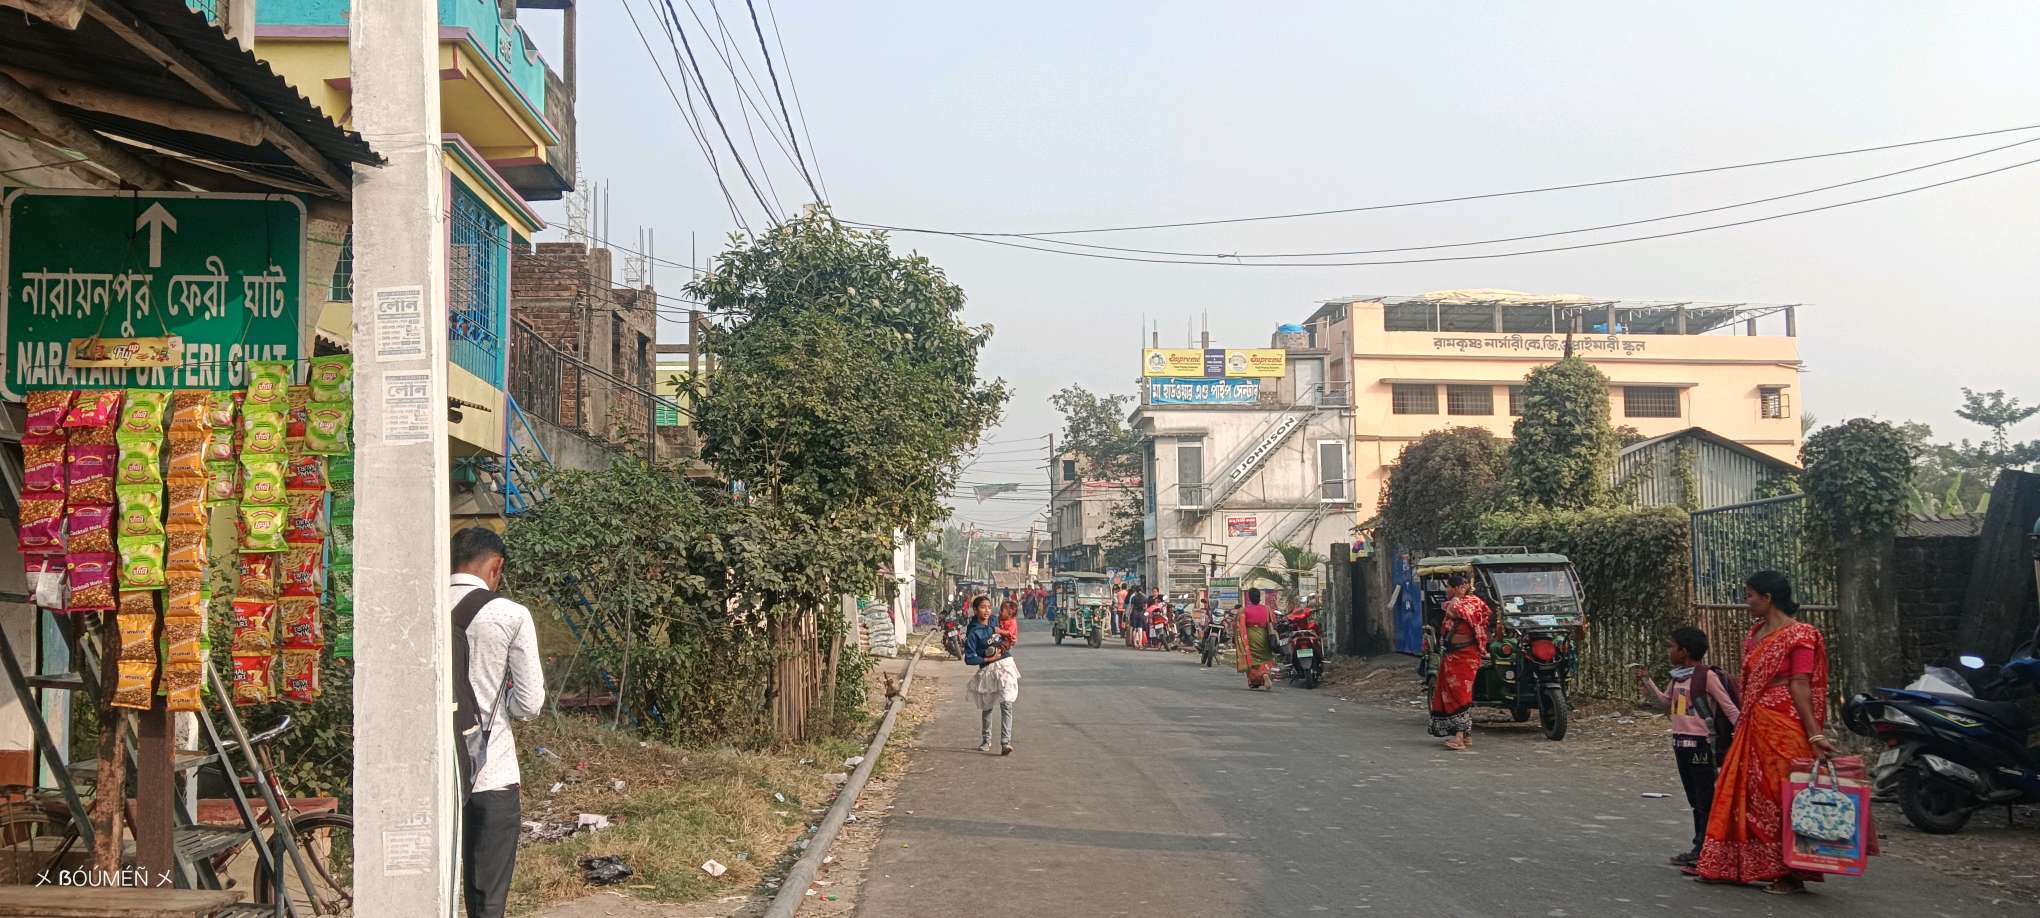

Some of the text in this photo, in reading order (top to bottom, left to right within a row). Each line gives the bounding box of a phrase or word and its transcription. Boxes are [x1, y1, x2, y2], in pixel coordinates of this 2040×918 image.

[167, 256, 229, 321] ফেরী
[243, 264, 286, 319] ঘাট
[380, 300, 418, 313] লোন
[1433, 337, 1482, 352] রামকৃষ্ণ
[1169, 353, 1200, 363] Supreme
[1250, 354, 1282, 364] Supreme
[387, 383, 427, 398] লোন
[1241, 417, 1295, 471] JOHNSON
